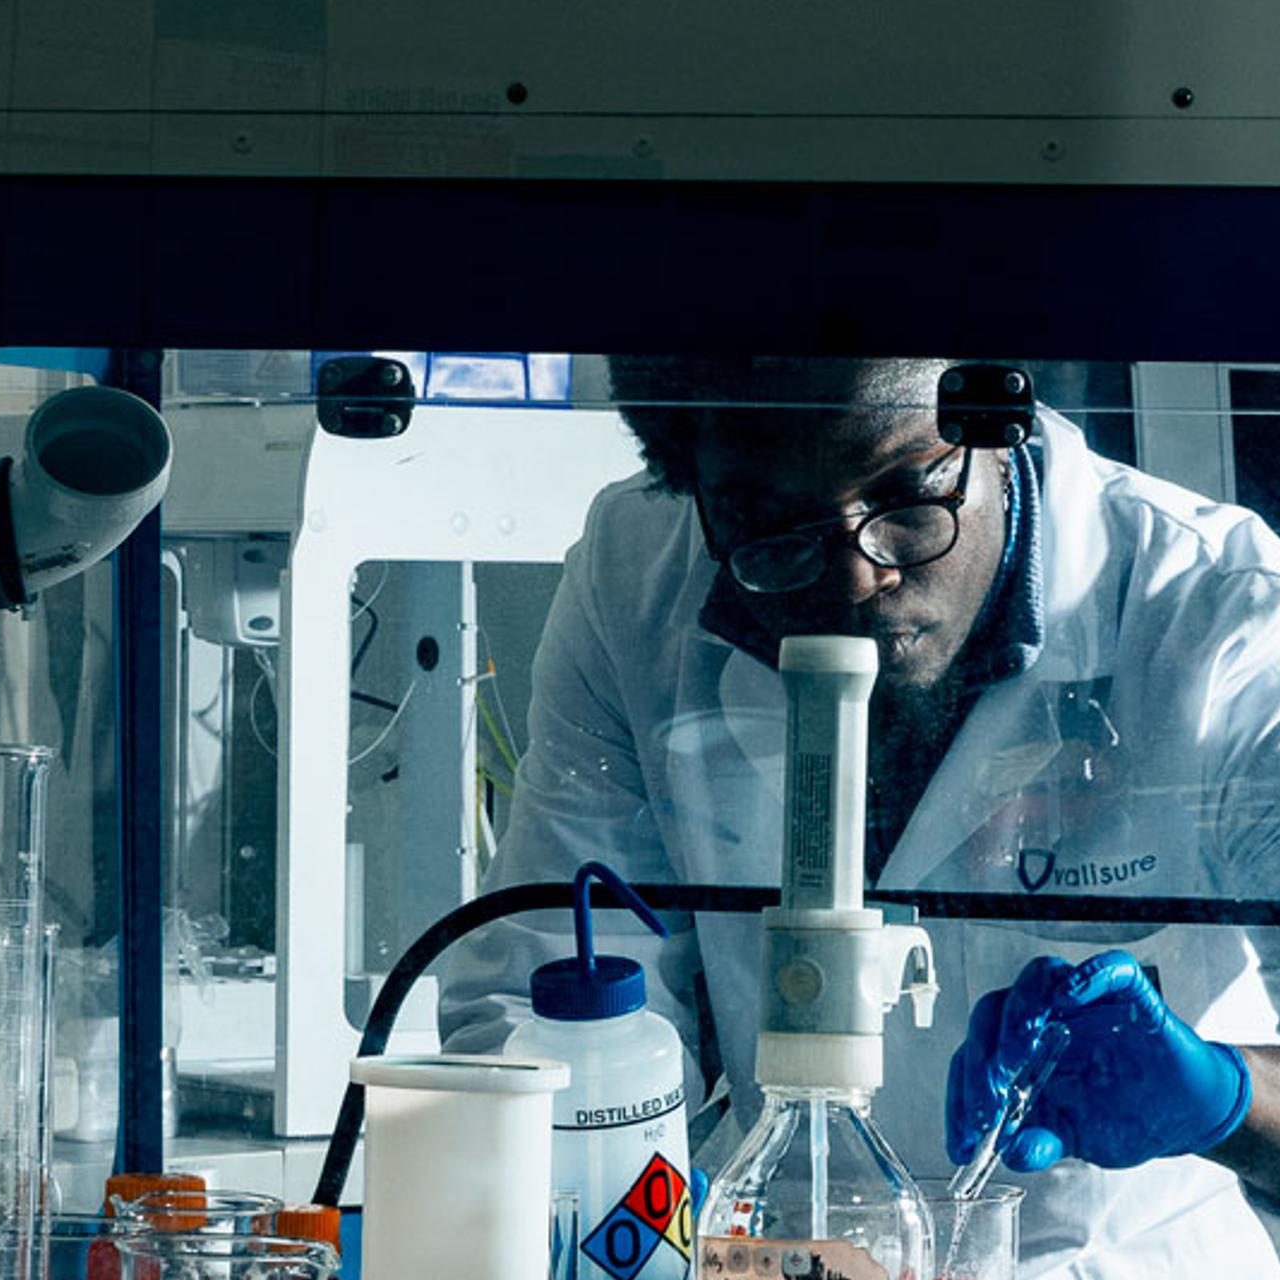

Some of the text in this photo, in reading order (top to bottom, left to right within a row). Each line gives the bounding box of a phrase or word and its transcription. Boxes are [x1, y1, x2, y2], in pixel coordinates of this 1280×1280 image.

[1053, 853, 1158, 887] valisure
[575, 1097, 663, 1126] DISTILLED
[605, 1219, 641, 1269] 0
